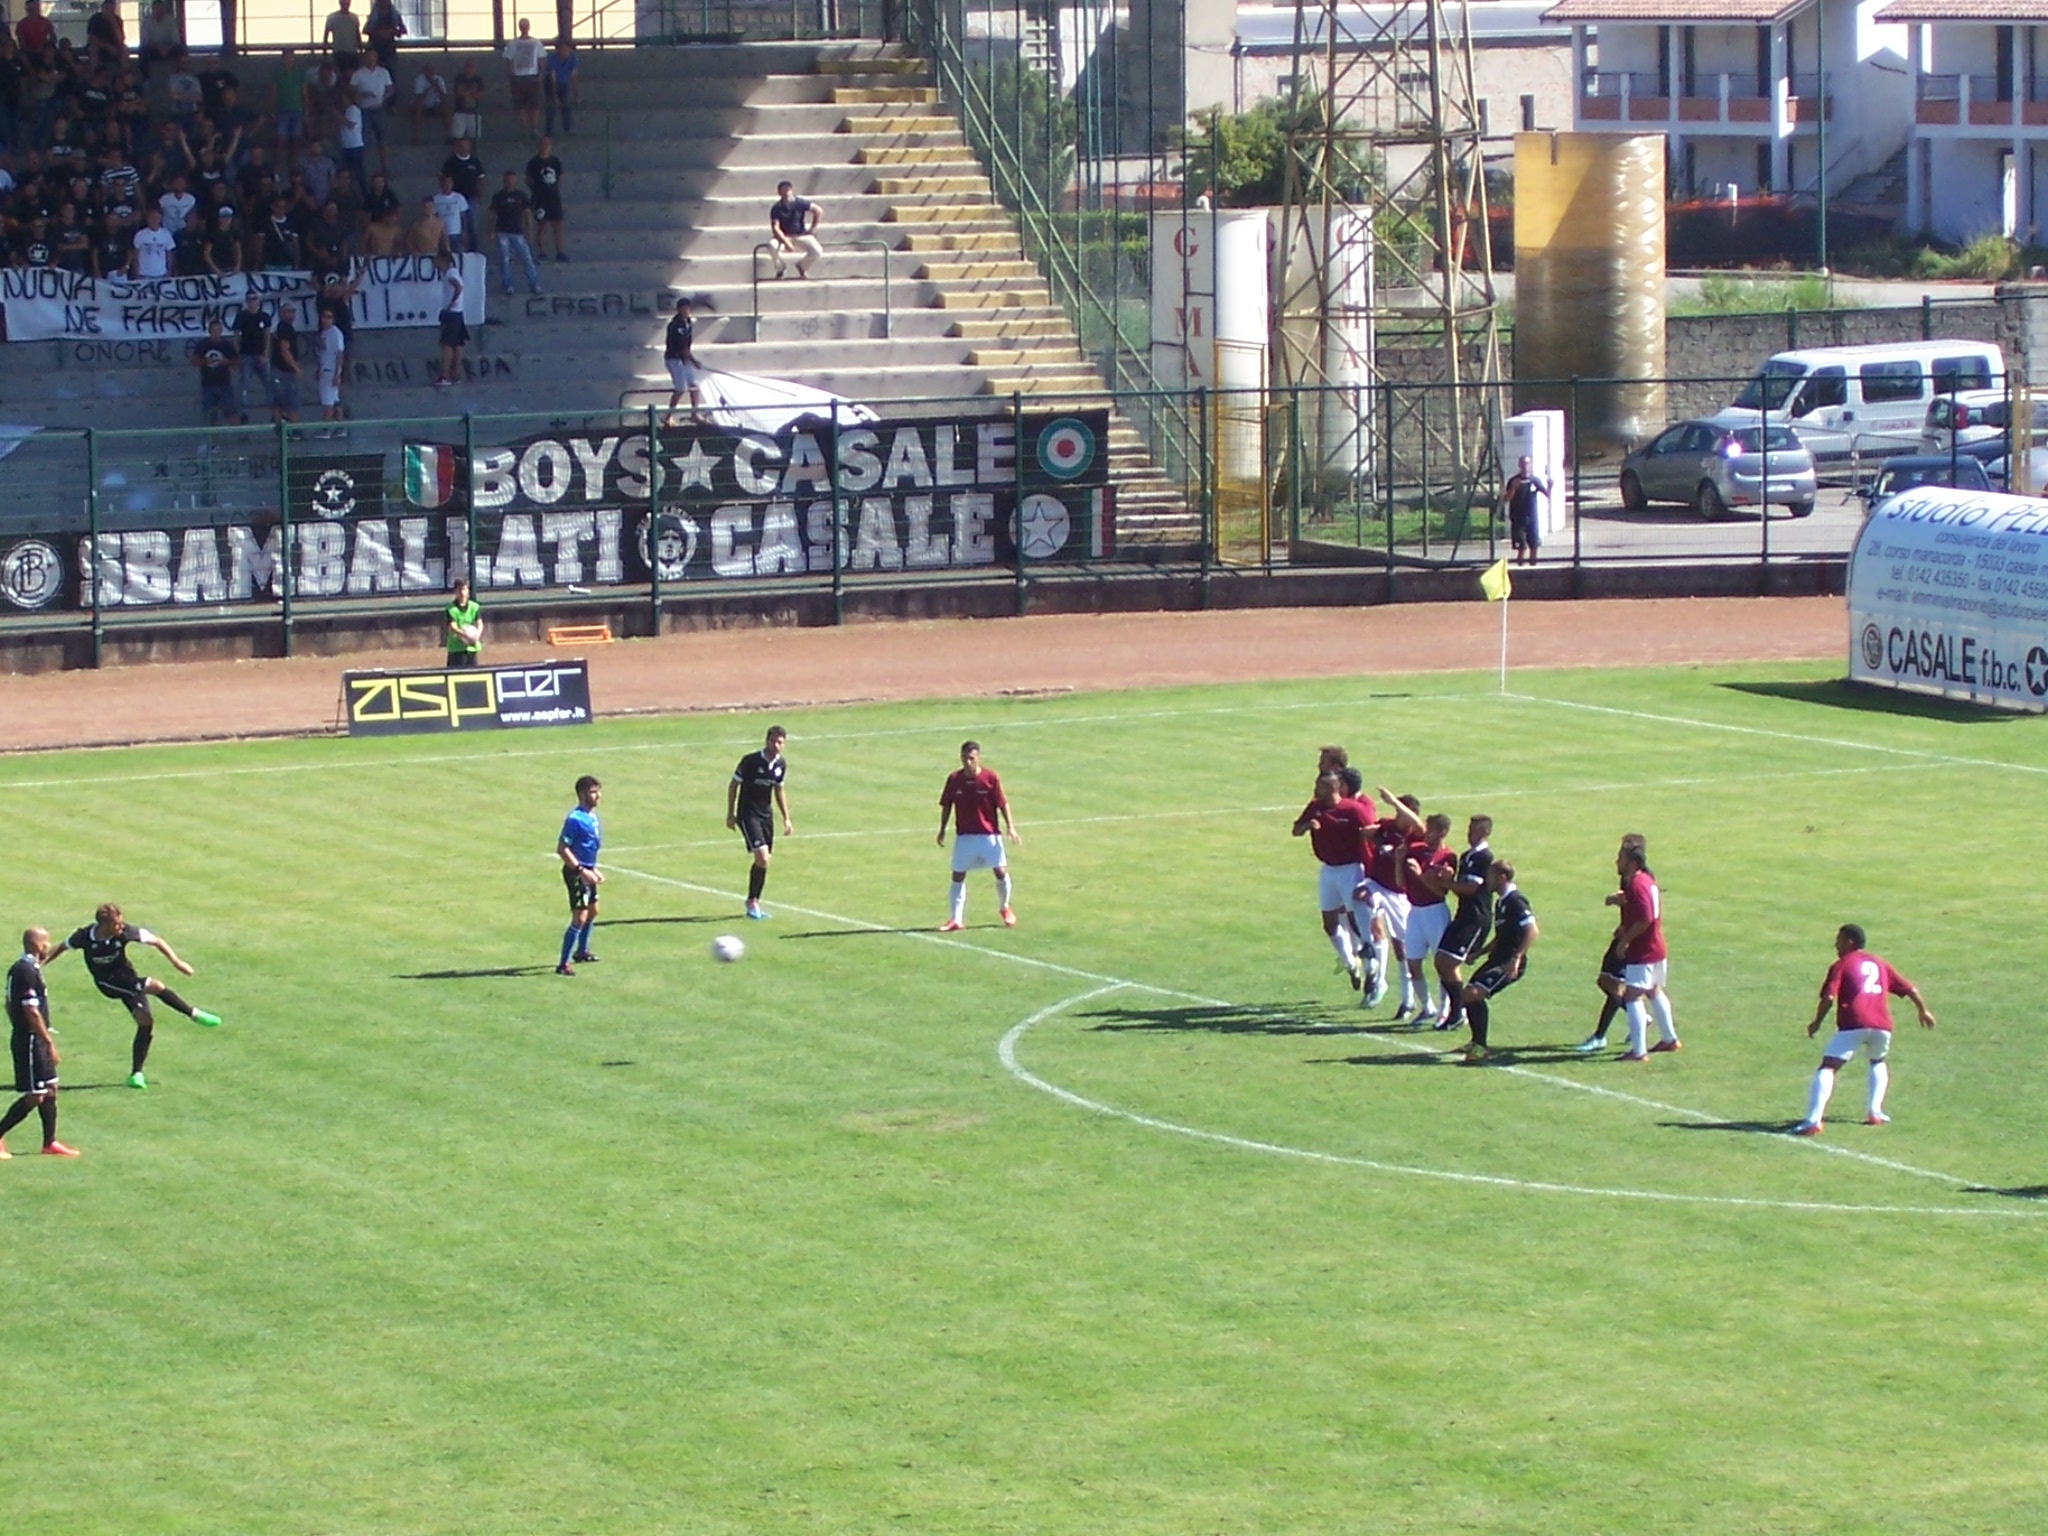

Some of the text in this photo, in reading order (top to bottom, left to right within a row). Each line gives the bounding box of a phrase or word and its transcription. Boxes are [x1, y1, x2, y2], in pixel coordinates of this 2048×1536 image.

[3, 269, 96, 301] NUOVA
[110, 274, 237, 301] STAGIONE
[64, 304, 102, 334] NE
[121, 302, 243, 333] FAREMO
[473, 421, 1017, 508] BOYS CASALE
[1887, 495, 1990, 528] studio
[78, 508, 624, 607] SBAMBALLATI
[710, 492, 995, 578] CASALE
[1908, 564, 1932, 584] 0142
[1887, 625, 1977, 684] CASALE
[500, 706, 587, 724] www.aspfer.it
[1860, 960, 1883, 994] 2
